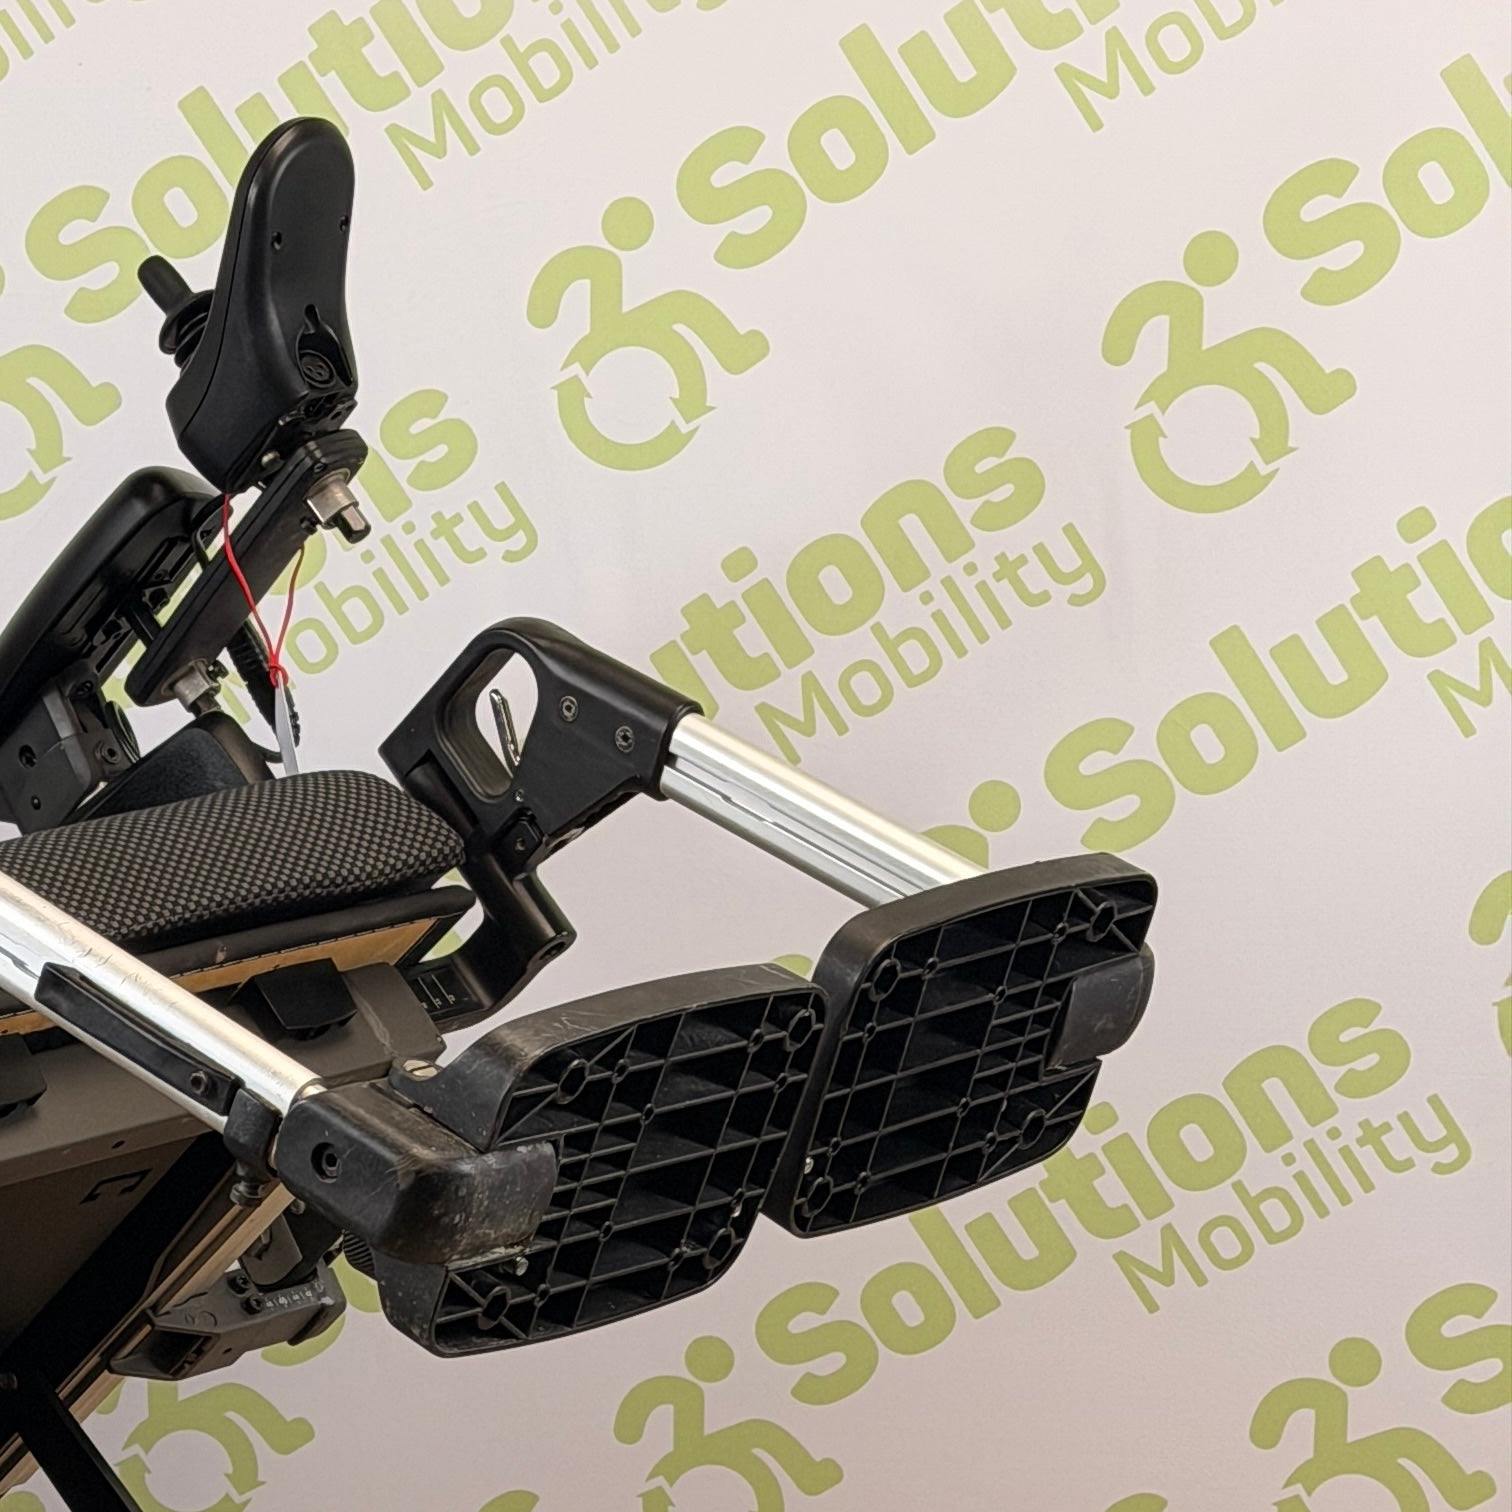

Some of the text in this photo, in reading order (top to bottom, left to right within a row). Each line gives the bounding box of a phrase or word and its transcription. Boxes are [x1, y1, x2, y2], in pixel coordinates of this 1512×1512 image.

[676, 0, 1118, 268] Solut
[1263, 56, 1512, 306] Sol
[284, 484, 536, 680] obility
[756, 525, 1105, 765] Mobility
[755, 999, 1411, 1405] Solutions
[1113, 1096, 1472, 1313] Mobility
